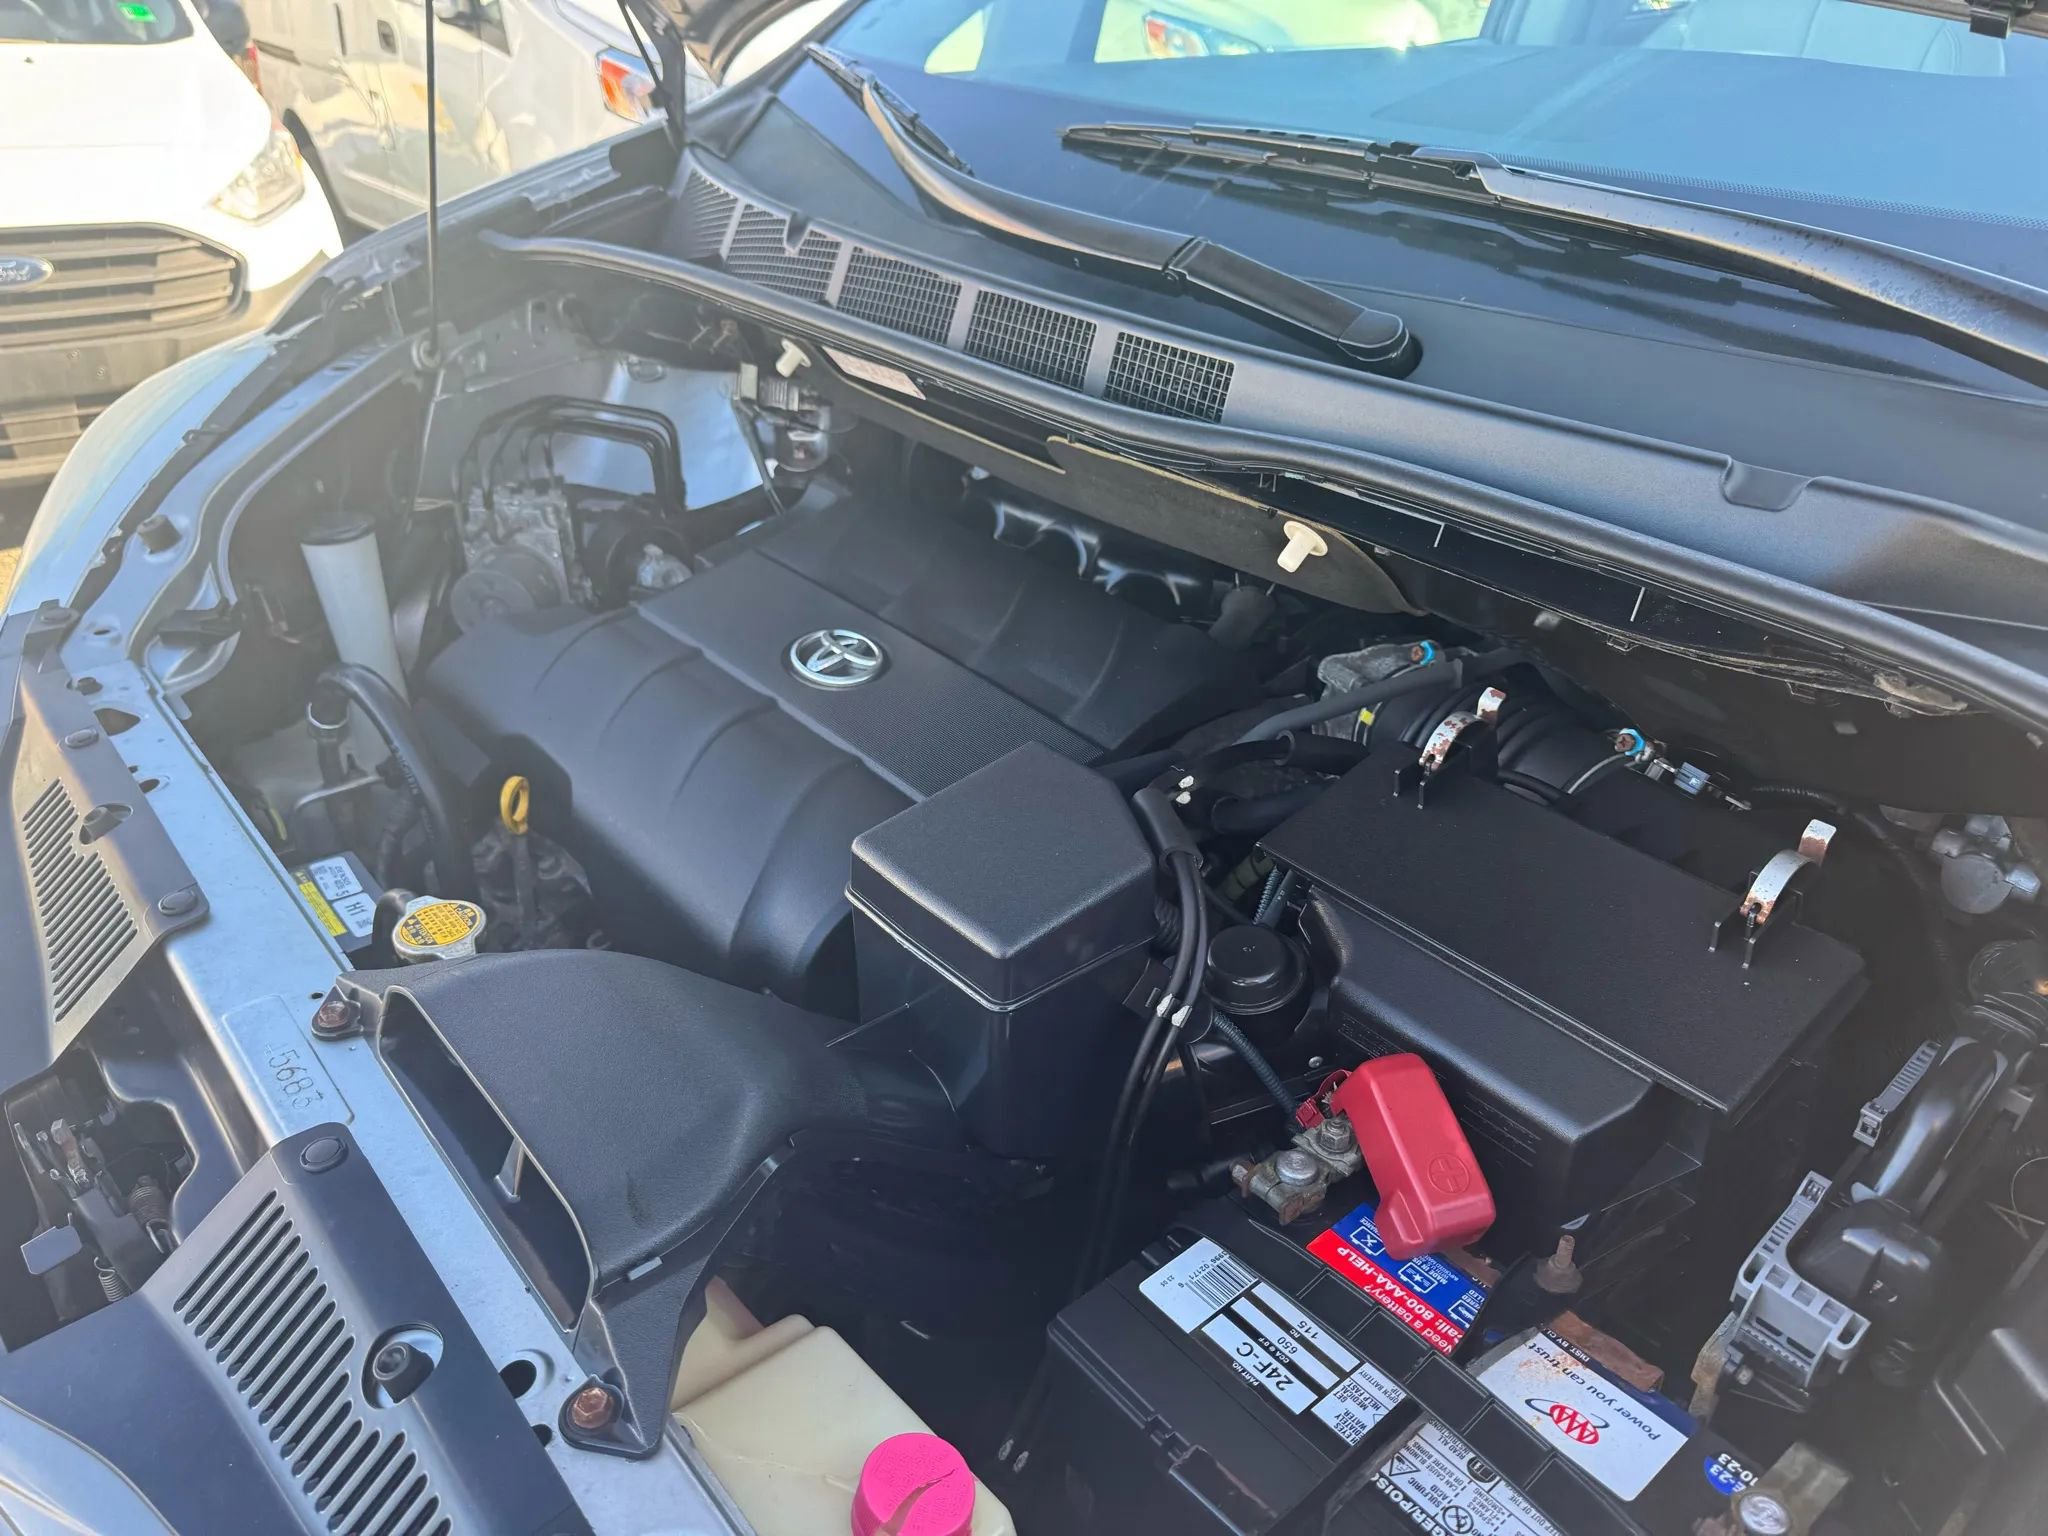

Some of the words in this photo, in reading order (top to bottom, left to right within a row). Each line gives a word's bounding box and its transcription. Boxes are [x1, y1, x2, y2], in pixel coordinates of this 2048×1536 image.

[1335, 1243, 1435, 1322] 800-AAA-HELP
[1362, 1279, 1415, 1323] battery?
[1288, 1327, 1301, 1338] RC
[1296, 1319, 1321, 1340] 115
[1412, 1318, 1424, 1329] a
[1275, 1334, 1300, 1355] 650
[1230, 1360, 1245, 1372] NO.
[1235, 1342, 1293, 1390] 24F-C
[1275, 1351, 1290, 1363] CCA
[1241, 1370, 1260, 1386] PART
[1560, 1365, 1585, 1387] can
[1332, 1389, 1348, 1403] GET
[1338, 1384, 1369, 1410] MEDICAL
[1344, 1379, 1365, 1397] FAST.
[1381, 1388, 1399, 1403] OPEN
[1587, 1383, 1617, 1406] you
[1361, 1393, 1381, 1411] HELP
[1340, 1407, 1367, 1430] WATER.
[1548, 1404, 1600, 1445] AAA
[1614, 1402, 1661, 1441] Power
[1332, 1421, 1351, 1438] EYES
[1435, 1434, 1449, 1445] ALL
[1446, 1442, 1466, 1460] READ
[1425, 1462, 1446, 1480] CAUSE
[1430, 1457, 1454, 1478] SEVERE
[1718, 1453, 1759, 1486] 10-23
[1442, 1478, 1458, 1491] CAN
[1451, 1475, 1464, 1486] OR
[1406, 1476, 1443, 1507] SULFURIC
[1428, 1483, 1449, 1501] ACID
